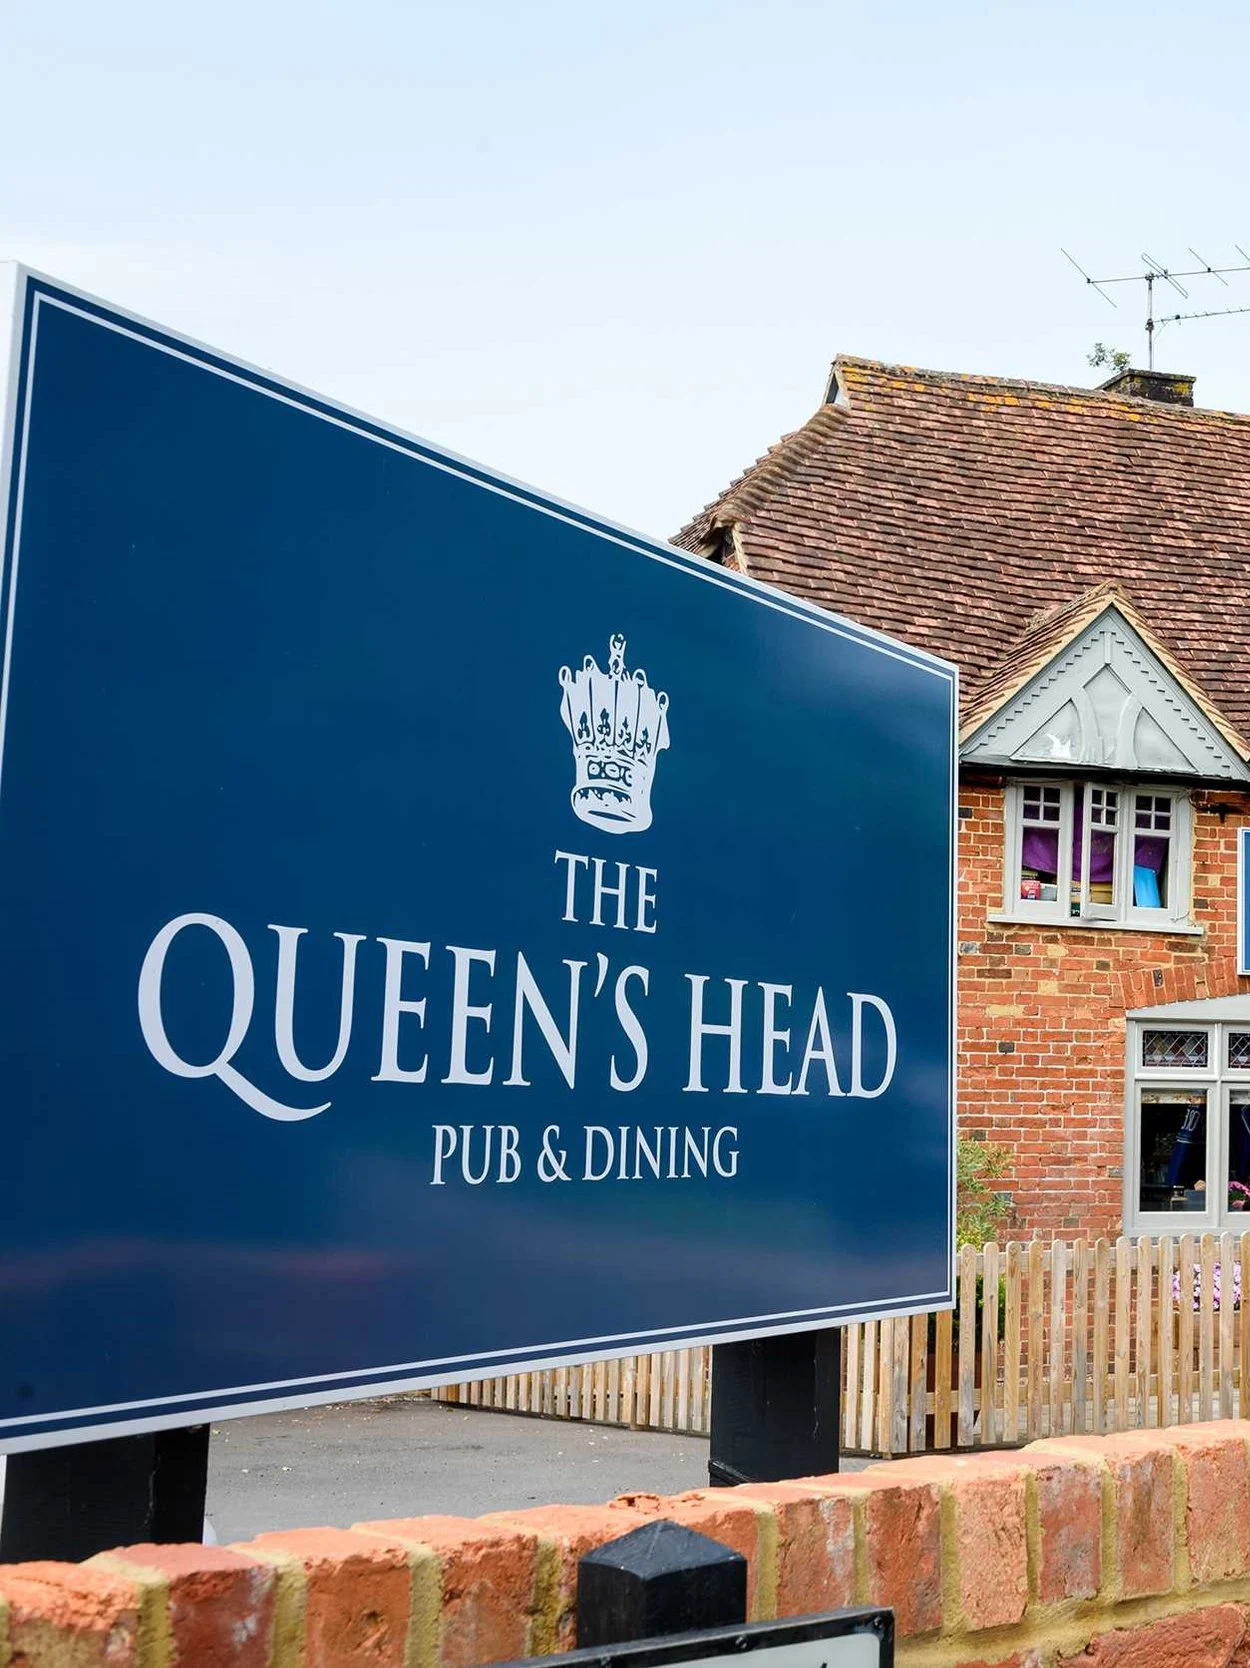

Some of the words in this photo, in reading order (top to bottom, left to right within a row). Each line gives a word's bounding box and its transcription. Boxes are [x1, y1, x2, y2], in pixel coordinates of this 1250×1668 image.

[555, 850, 657, 933] THE
[138, 912, 649, 1122] QUEEN'S
[683, 973, 897, 1099] HEAD
[431, 1125, 520, 1185] PUB
[538, 1124, 571, 1183] &
[583, 1126, 739, 1181] DINING
